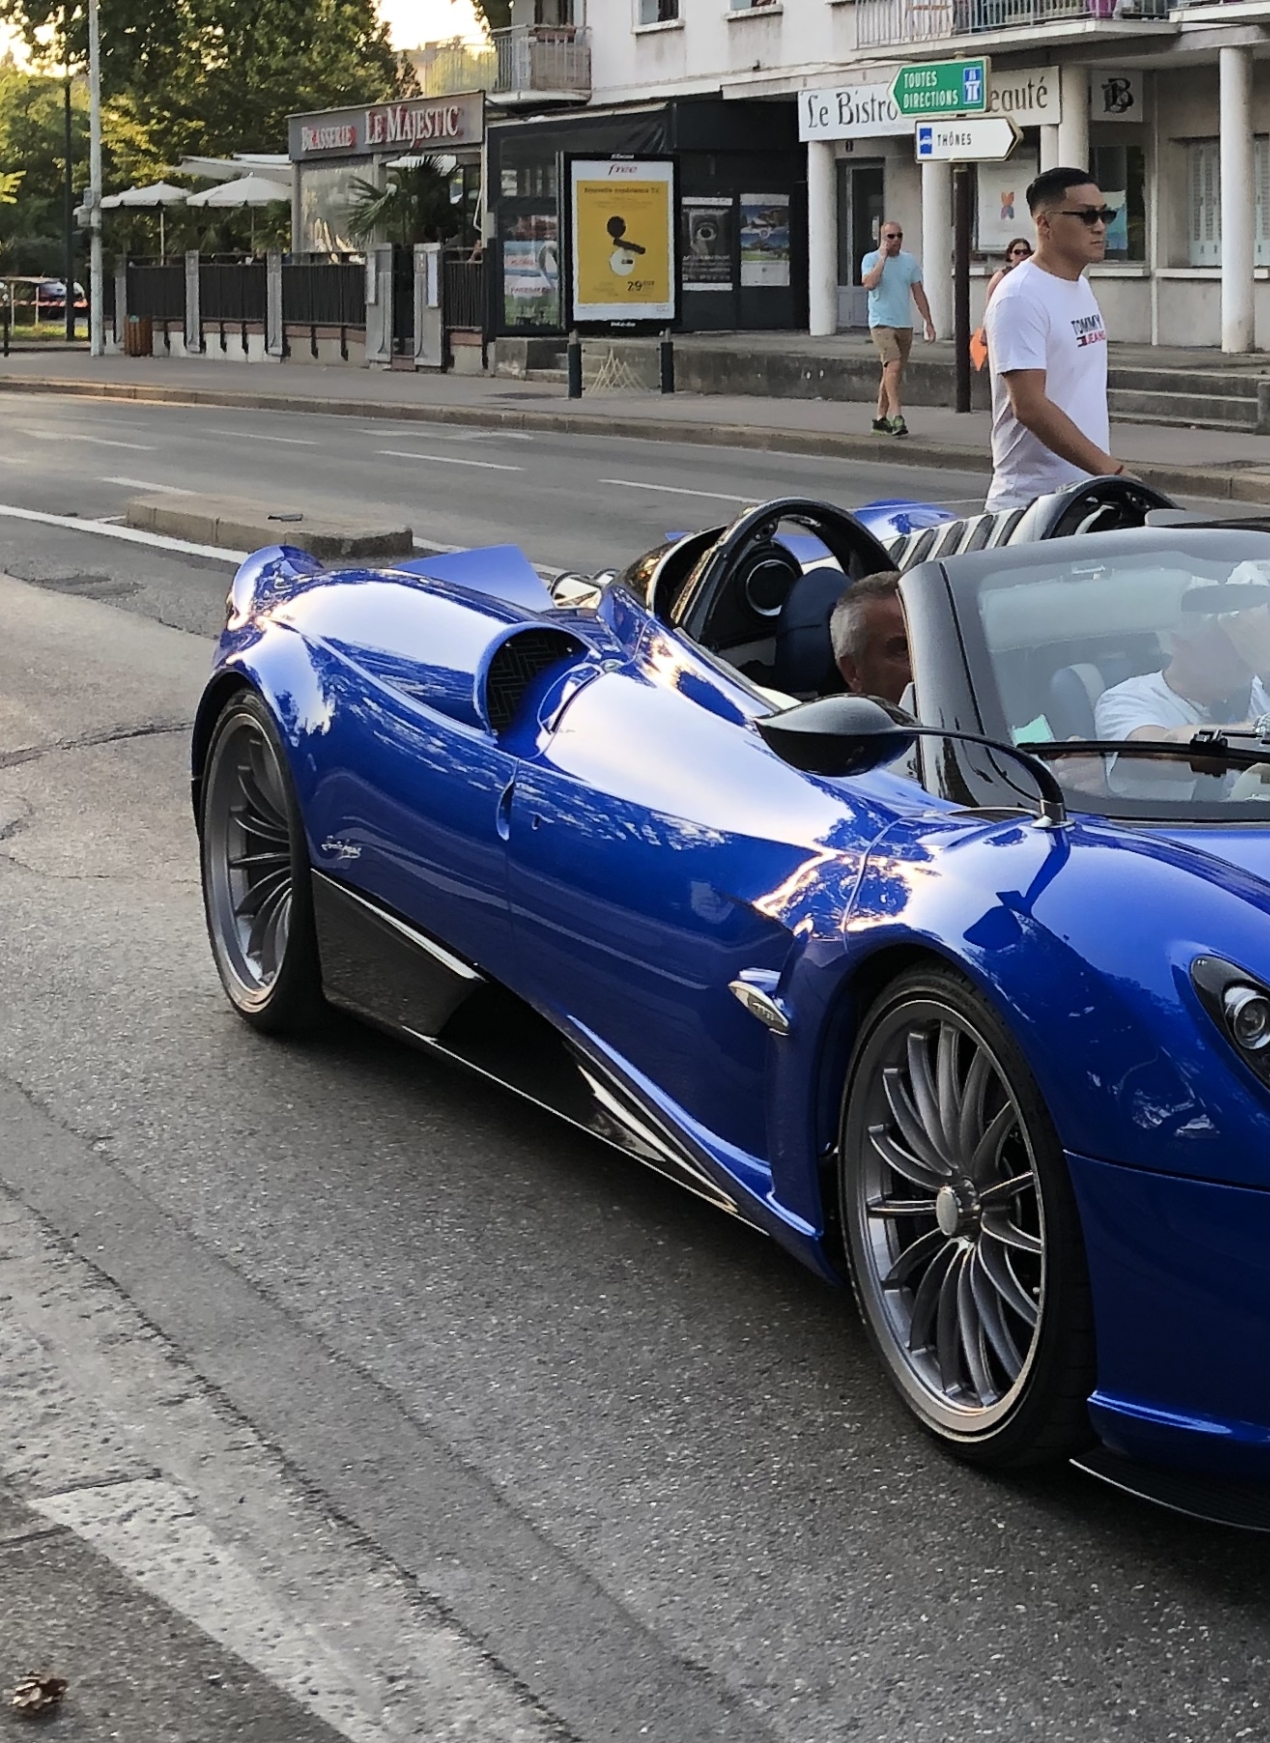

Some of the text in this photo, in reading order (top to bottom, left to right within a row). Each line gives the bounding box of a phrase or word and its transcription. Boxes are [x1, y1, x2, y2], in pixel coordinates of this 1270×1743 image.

[904, 70, 937, 89] TOUTES
[903, 90, 959, 109] DIRECTIONS
[807, 95, 829, 128] Le
[301, 105, 460, 150] BRASSERIE LE MAJESTIC
[937, 131, 972, 147] THÔNES
[608, 163, 638, 176] free
[1071, 314, 1103, 335] TOMMY
